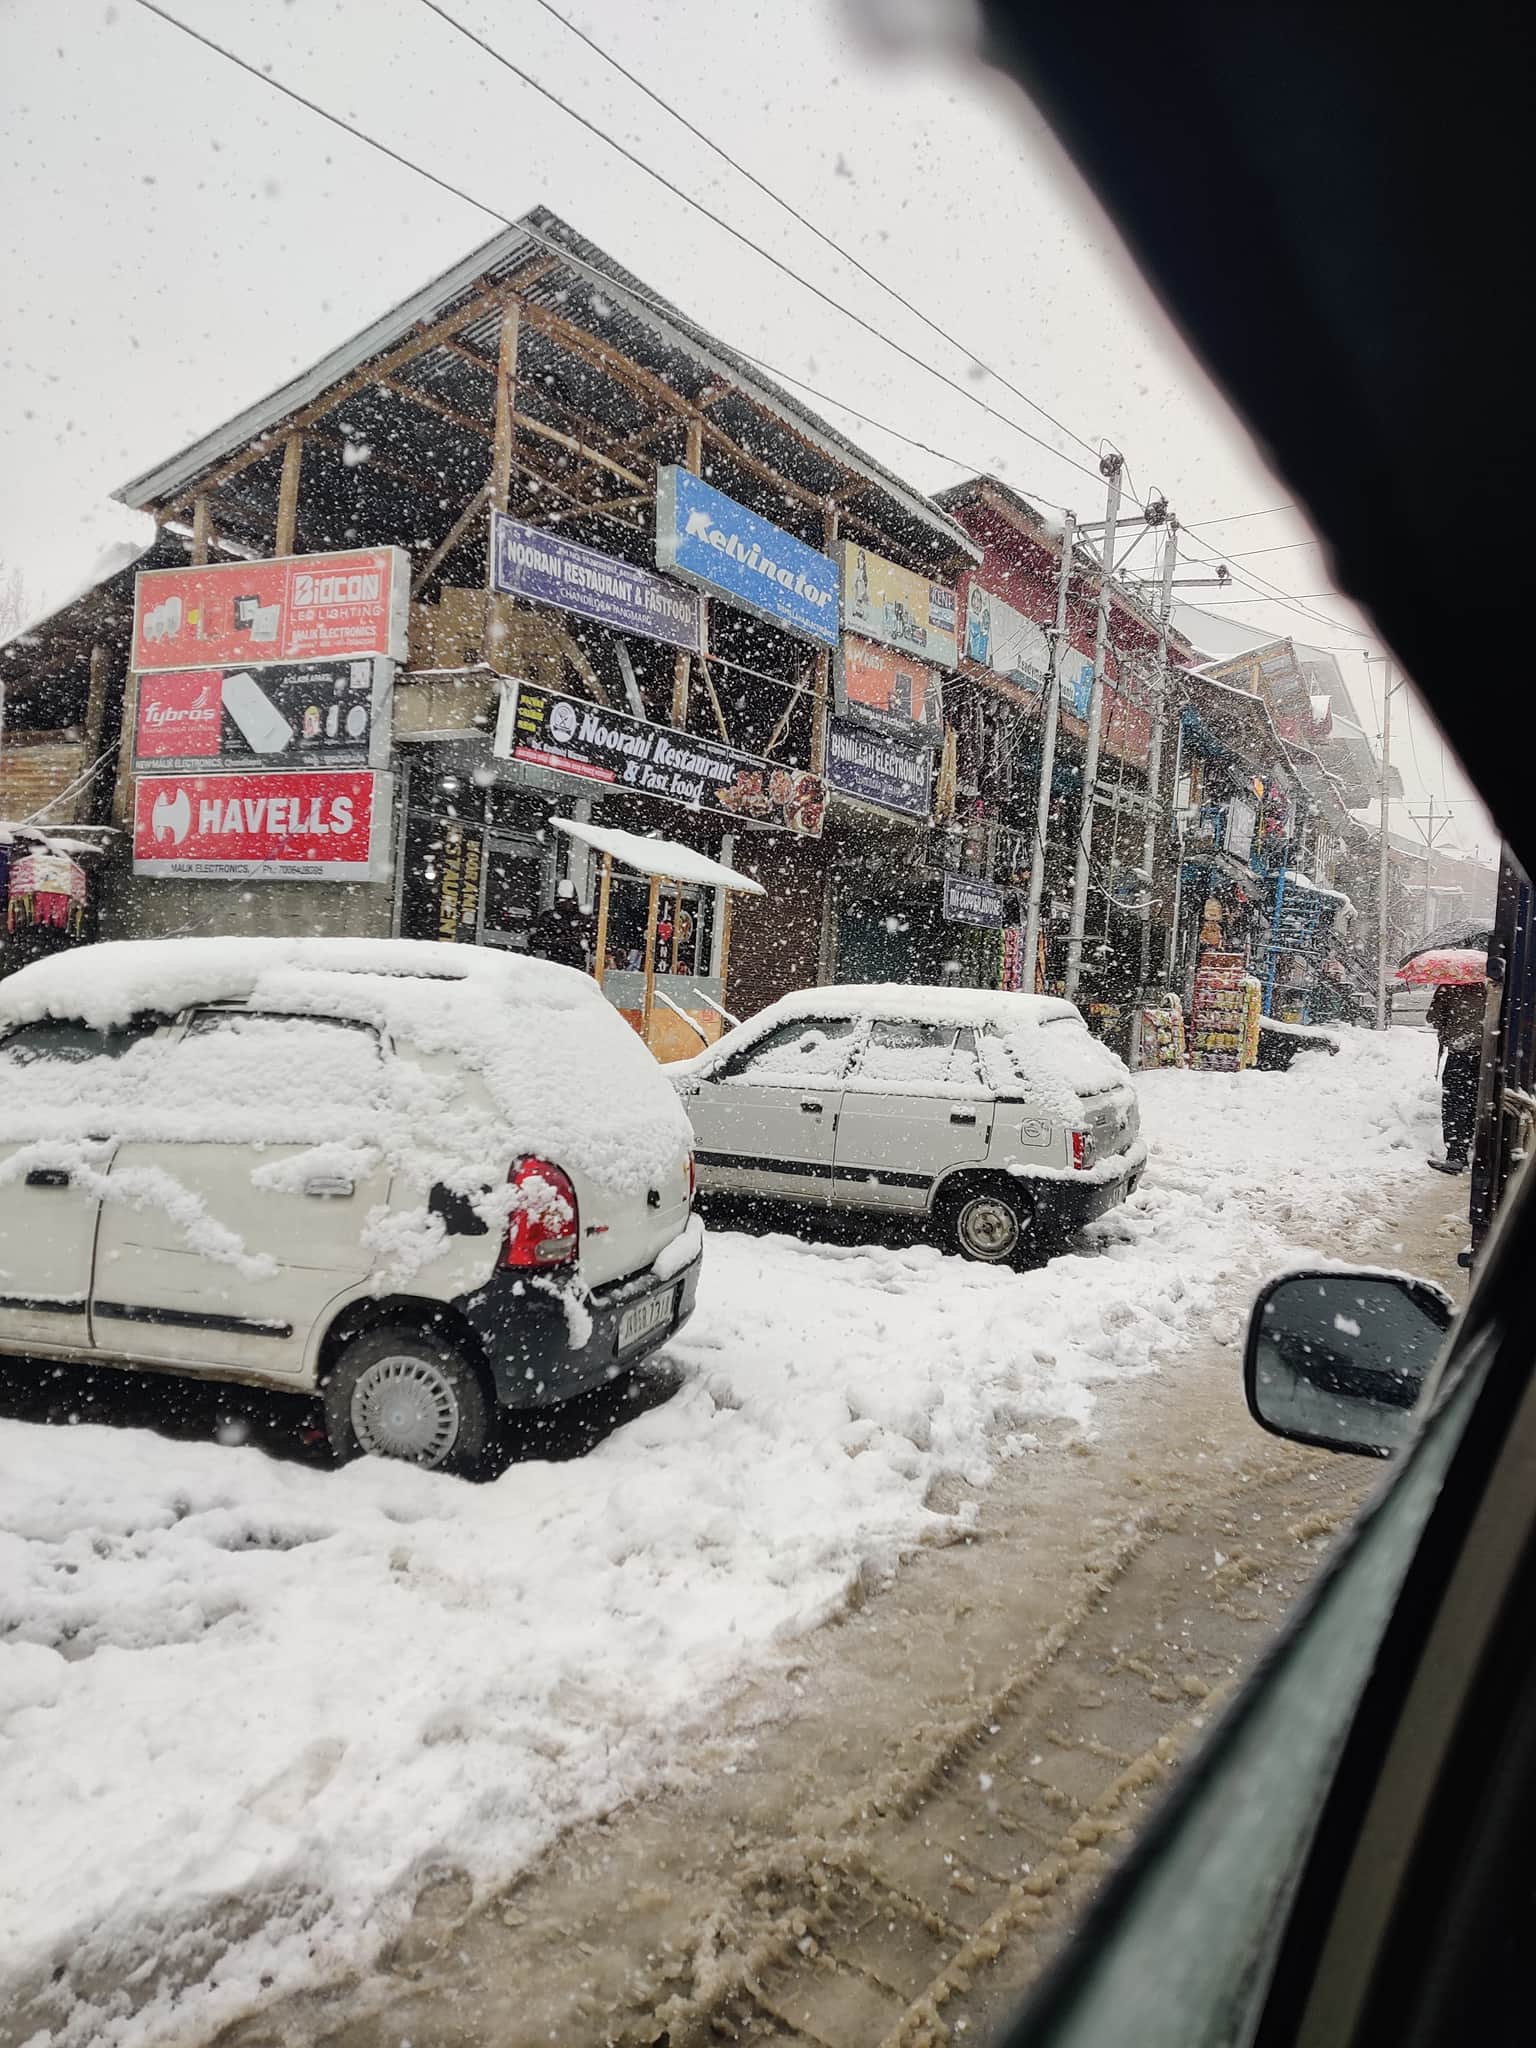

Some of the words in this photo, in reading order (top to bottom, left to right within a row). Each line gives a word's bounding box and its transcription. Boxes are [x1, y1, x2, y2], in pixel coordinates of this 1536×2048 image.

[507, 540, 561, 579] NOORANI
[564, 561, 633, 603] RESTAURANT
[634, 584, 644, 607] &
[685, 507, 832, 609] Kelvinator
[318, 604, 384, 620] LIGHTING
[144, 701, 216, 728] fybros
[578, 712, 653, 759] Noorani
[652, 737, 736, 783] Restaurant
[830, 734, 875, 769] BISMILLAH
[875, 745, 925, 787] ELECTRONICS
[623, 760, 640, 787] &
[639, 765, 670, 793] Fast
[670, 772, 704, 800] Food
[198, 796, 354, 835] HAVELLS
[171, 863, 194, 873] MALIK
